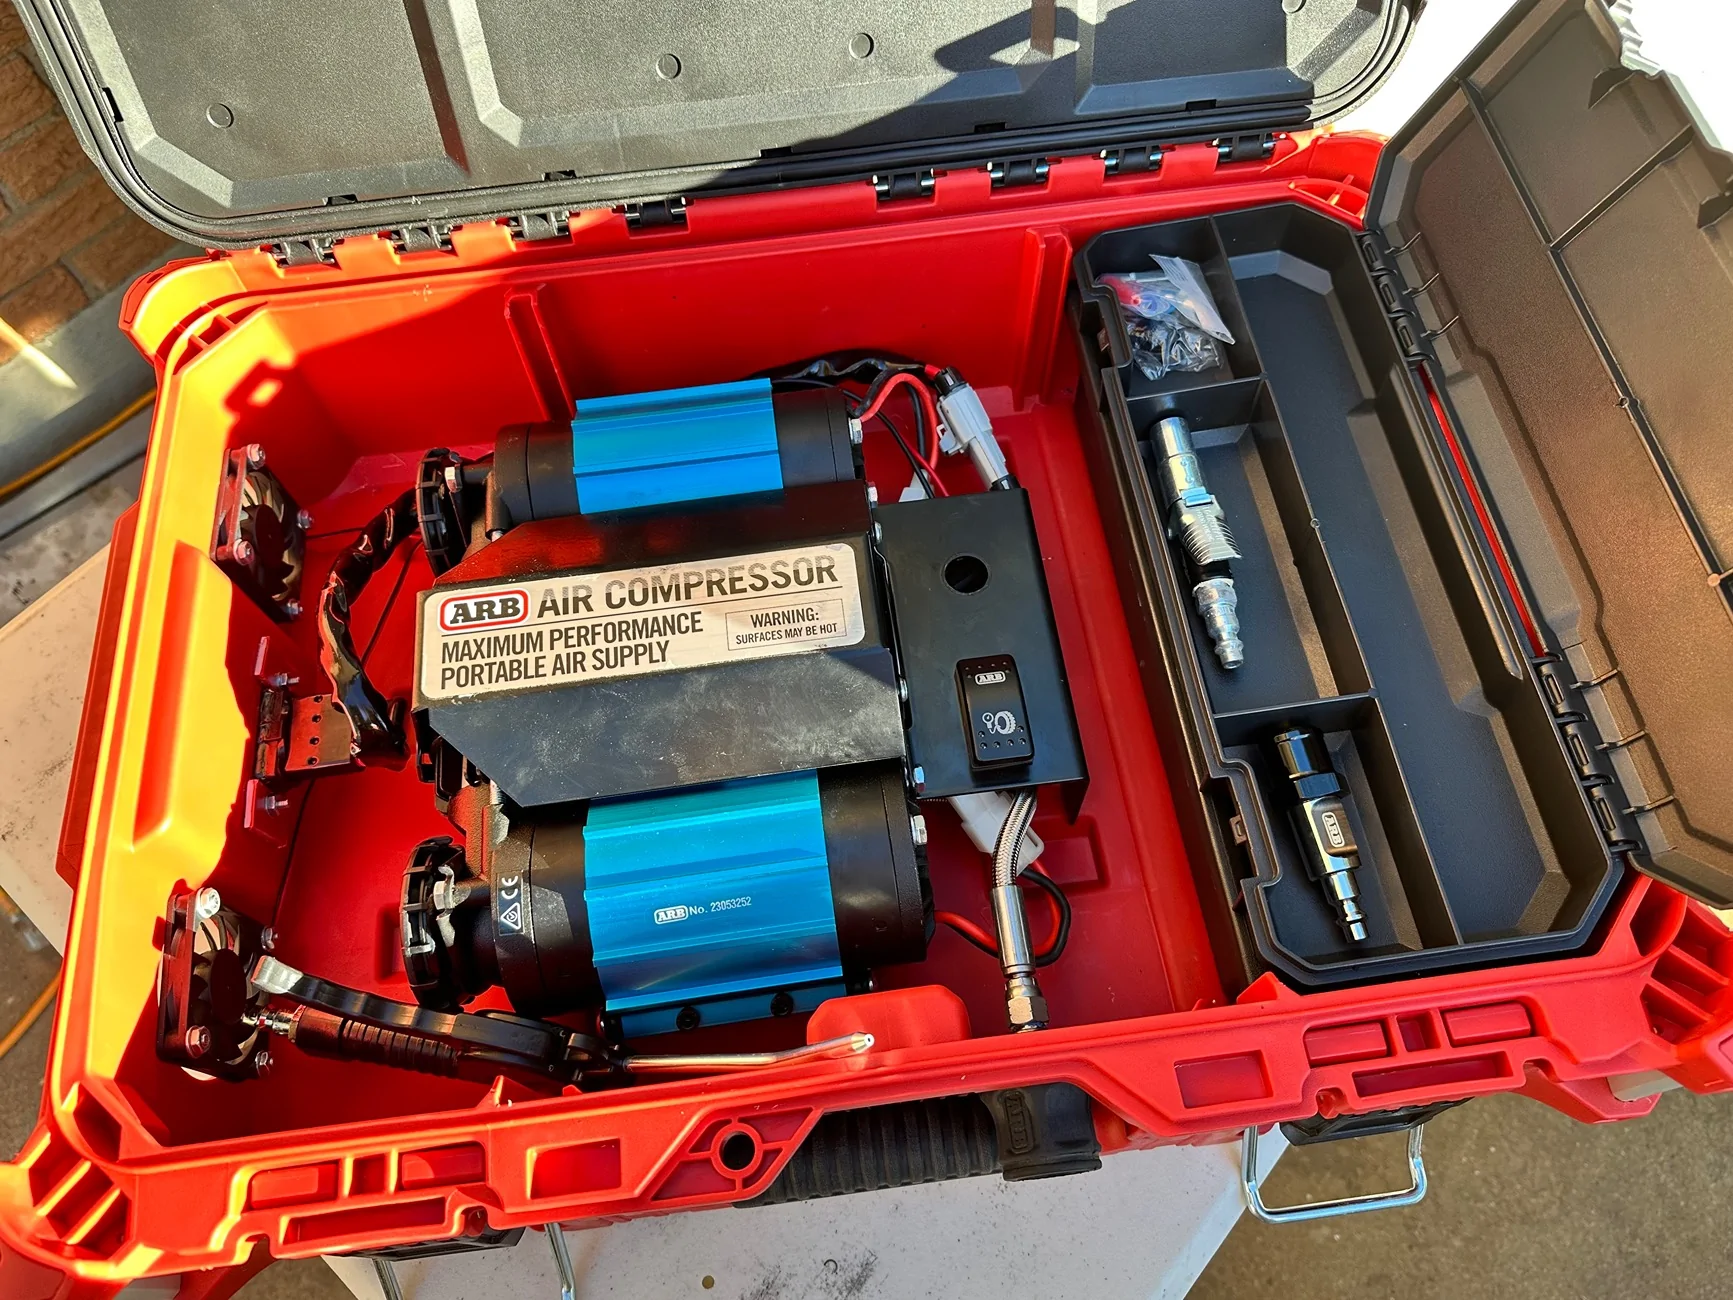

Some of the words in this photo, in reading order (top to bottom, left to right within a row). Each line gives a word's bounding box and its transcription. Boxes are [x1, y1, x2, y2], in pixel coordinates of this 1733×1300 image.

[537, 584, 594, 618] AIR
[605, 555, 838, 609] COMPRESSOR
[450, 597, 520, 624] ARB
[750, 607, 819, 628] WARNING:
[441, 631, 543, 664] MAXIMUM
[550, 611, 703, 650] PERFORMANCE
[736, 629, 783, 645] SURFACES
[785, 628, 802, 639] MAY
[806, 626, 817, 635] BE
[820, 622, 837, 634] HOT
[441, 655, 546, 690] PORTABLE
[551, 651, 586, 676] AIR
[592, 640, 669, 670] SUPPLY
[1324, 815, 1342, 845] ARB
[501, 875, 519, 899] CE
[657, 908, 686, 922] ARB
[689, 905, 708, 915] No.
[710, 896, 752, 912] 23053252
